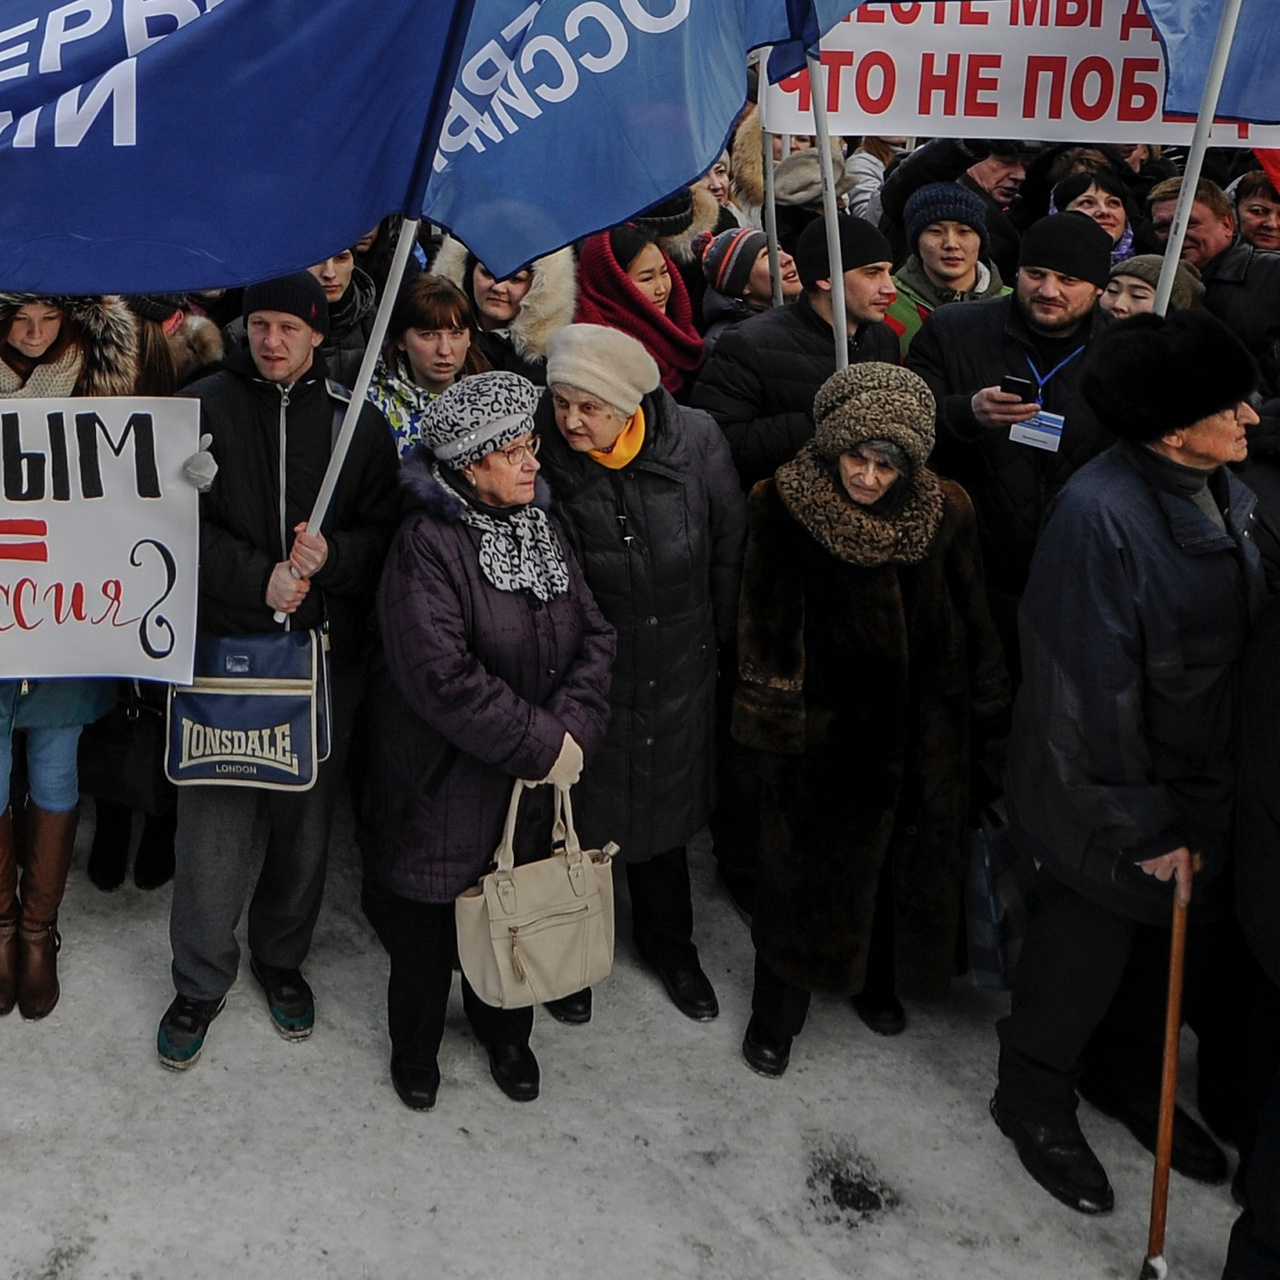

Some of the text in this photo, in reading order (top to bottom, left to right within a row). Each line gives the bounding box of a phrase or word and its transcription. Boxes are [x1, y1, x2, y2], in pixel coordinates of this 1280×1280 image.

[917, 52, 1003, 118] НЕ
[1021, 55, 1162, 123] ПОБ
[179, 717, 299, 776] LONSDALE
[216, 764, 258, 775] LONDON
